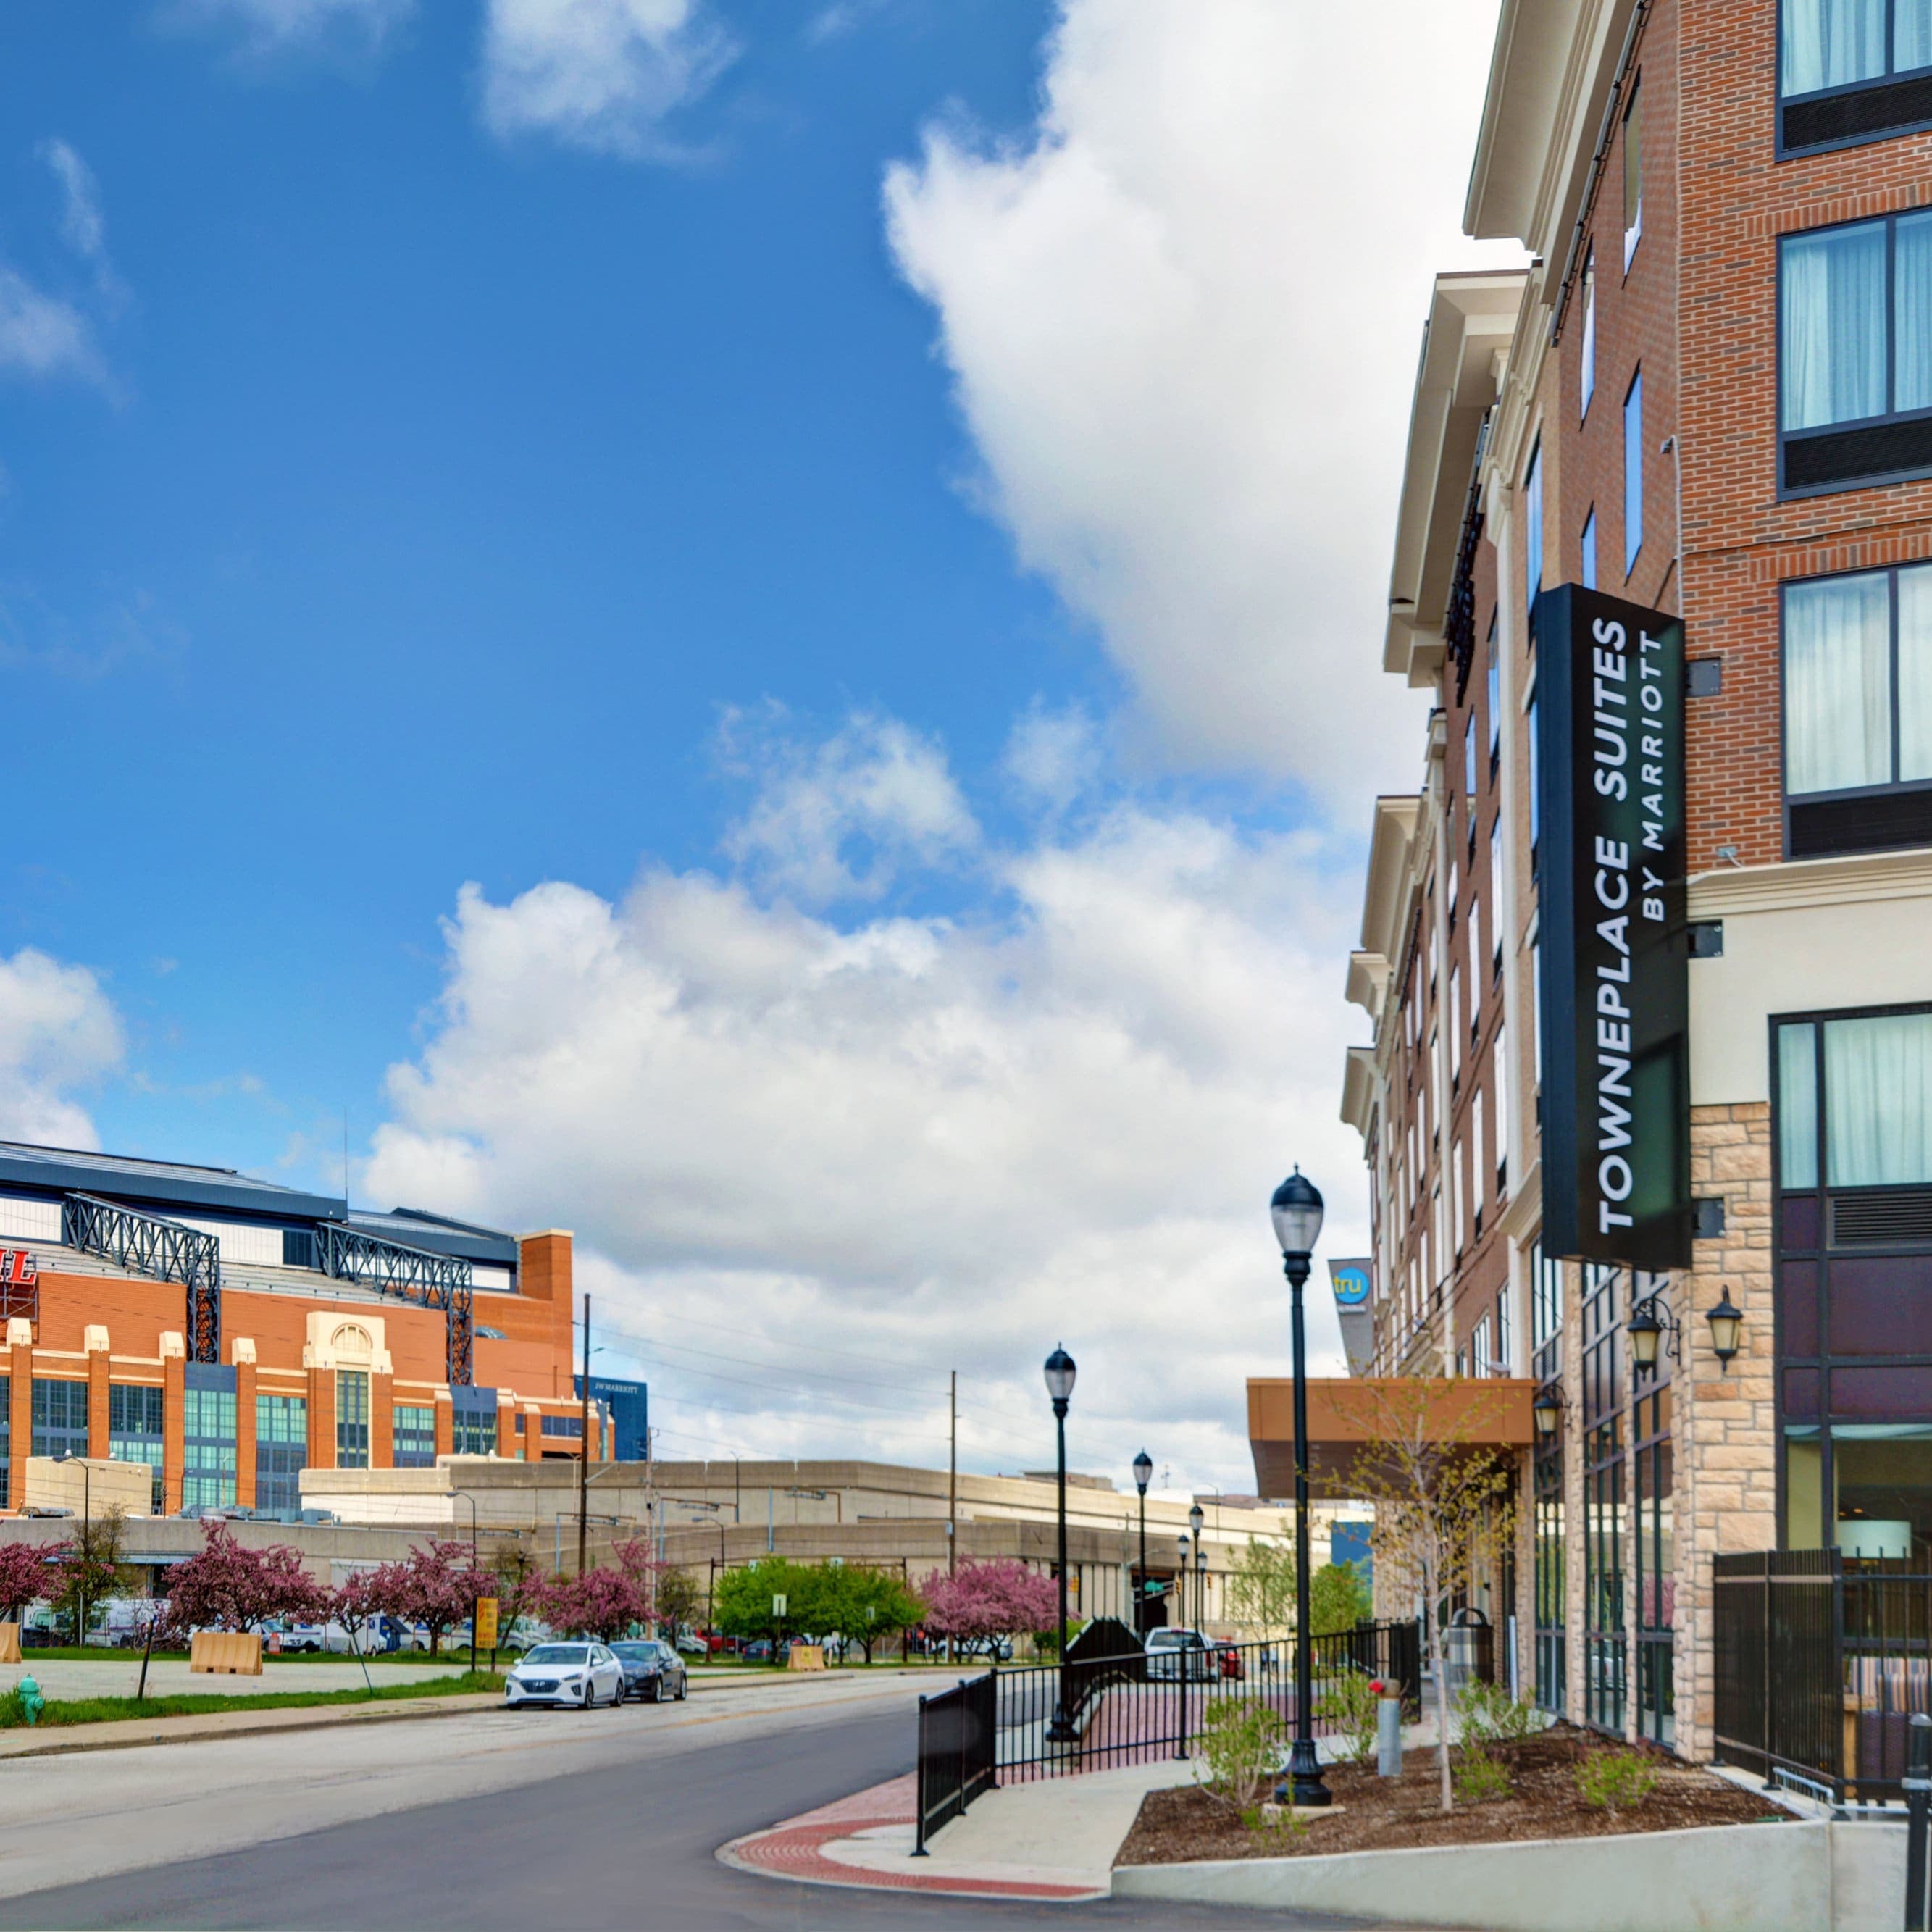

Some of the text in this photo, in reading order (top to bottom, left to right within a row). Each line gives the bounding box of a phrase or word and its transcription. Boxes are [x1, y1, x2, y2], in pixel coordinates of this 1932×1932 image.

[1640, 630, 1664, 921] BY MARRIOTT
[1593, 619, 1633, 1234] TOWNEPLACE SUITES
[1333, 1276, 1362, 1295] tru
